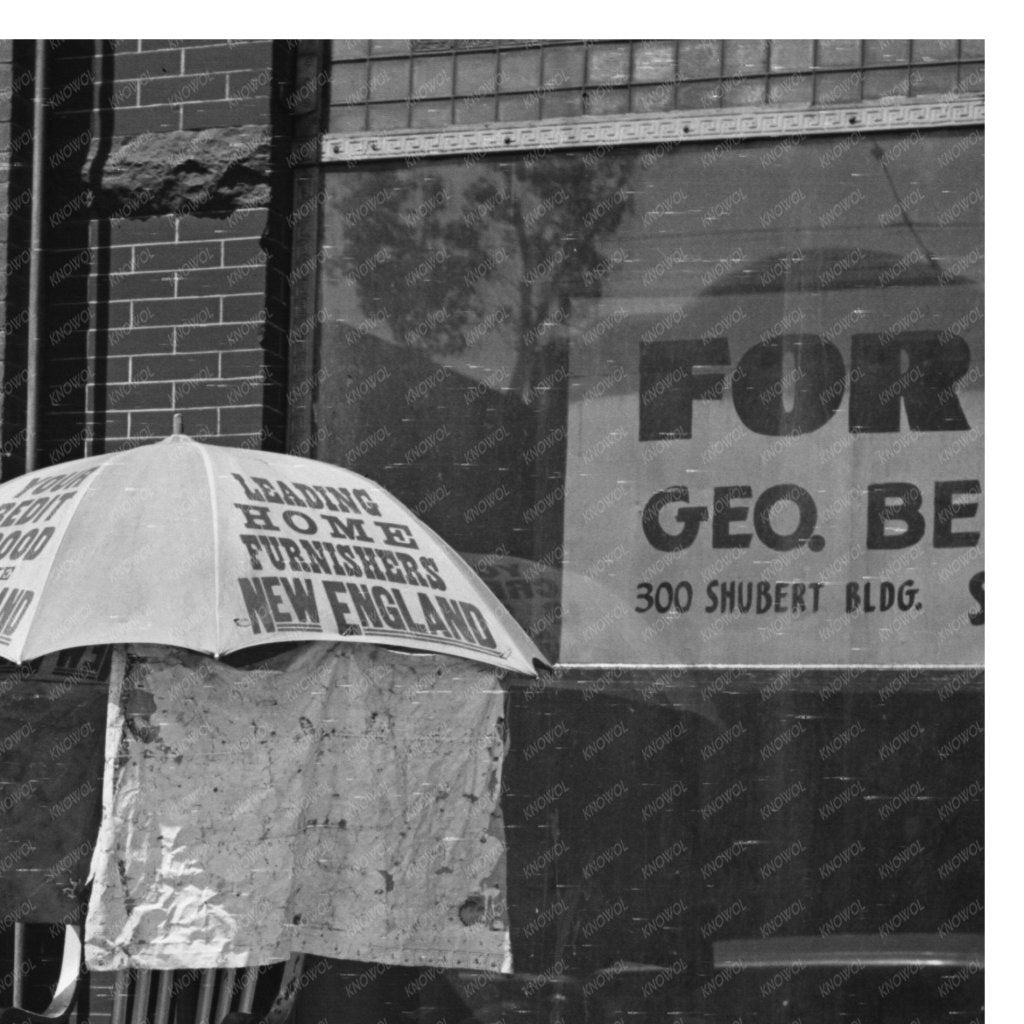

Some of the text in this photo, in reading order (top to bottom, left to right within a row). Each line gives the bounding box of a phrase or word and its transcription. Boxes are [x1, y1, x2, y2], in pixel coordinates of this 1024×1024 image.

[639, 330, 972, 441] FOR
[14, 466, 100, 498] YOUR
[231, 472, 382, 517] LEADING
[234, 503, 419, 550] HOME
[642, 479, 982, 553] GEO. BE
[240, 534, 447, 592] FURNISHERS
[238, 576, 320, 635] NEW
[322, 580, 497, 650] ENGLAND
[635, 581, 693, 614] 300
[705, 579, 825, 615] SHUBERT
[845, 579, 922, 614] BLDG.
